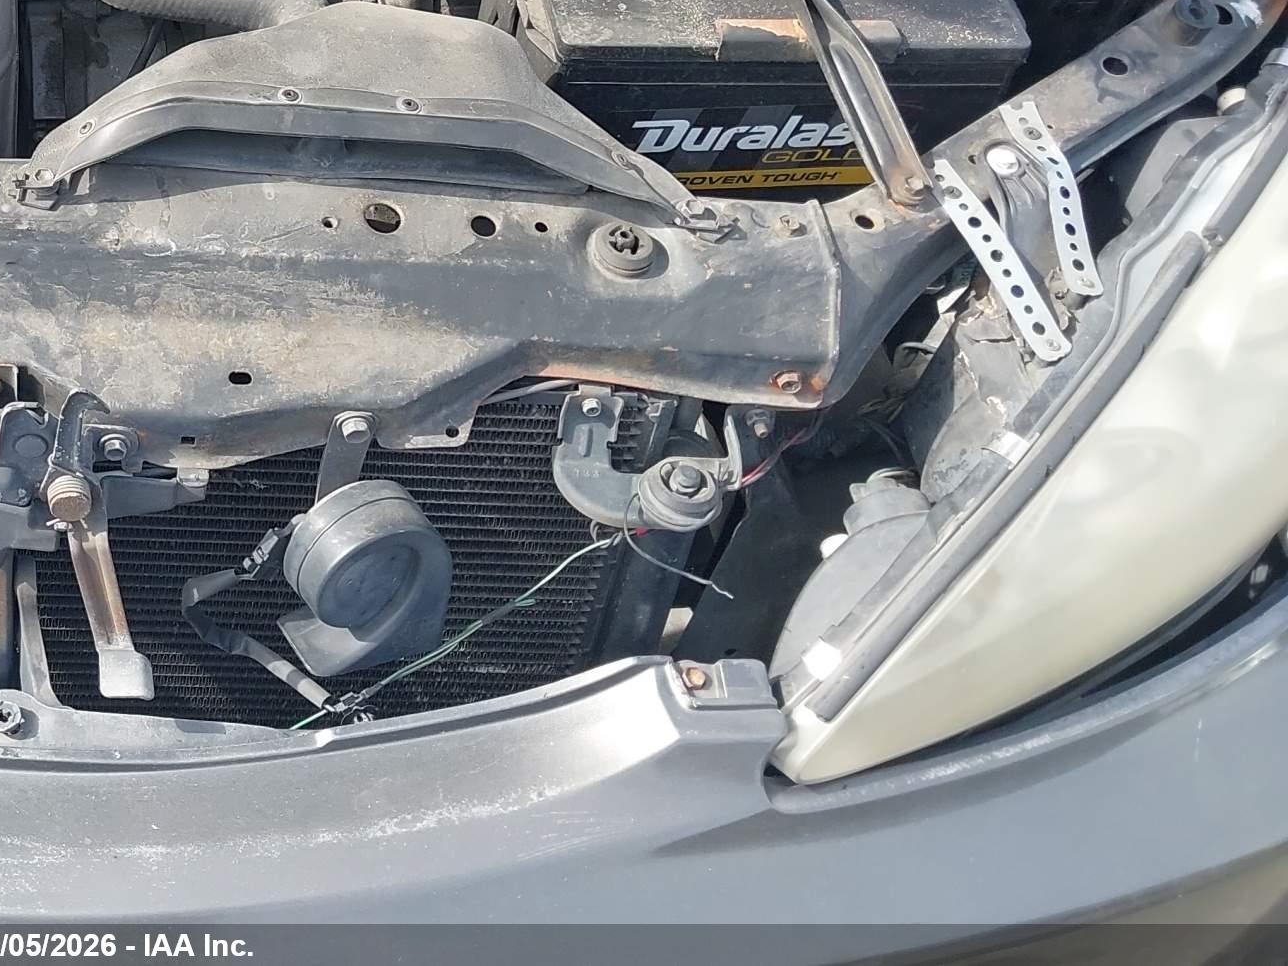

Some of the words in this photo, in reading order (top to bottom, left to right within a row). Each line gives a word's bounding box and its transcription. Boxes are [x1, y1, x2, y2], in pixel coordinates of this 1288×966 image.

[632, 115, 855, 153] Duralas
[678, 175, 754, 186] ROVEN
[762, 171, 838, 183] TOUGH
